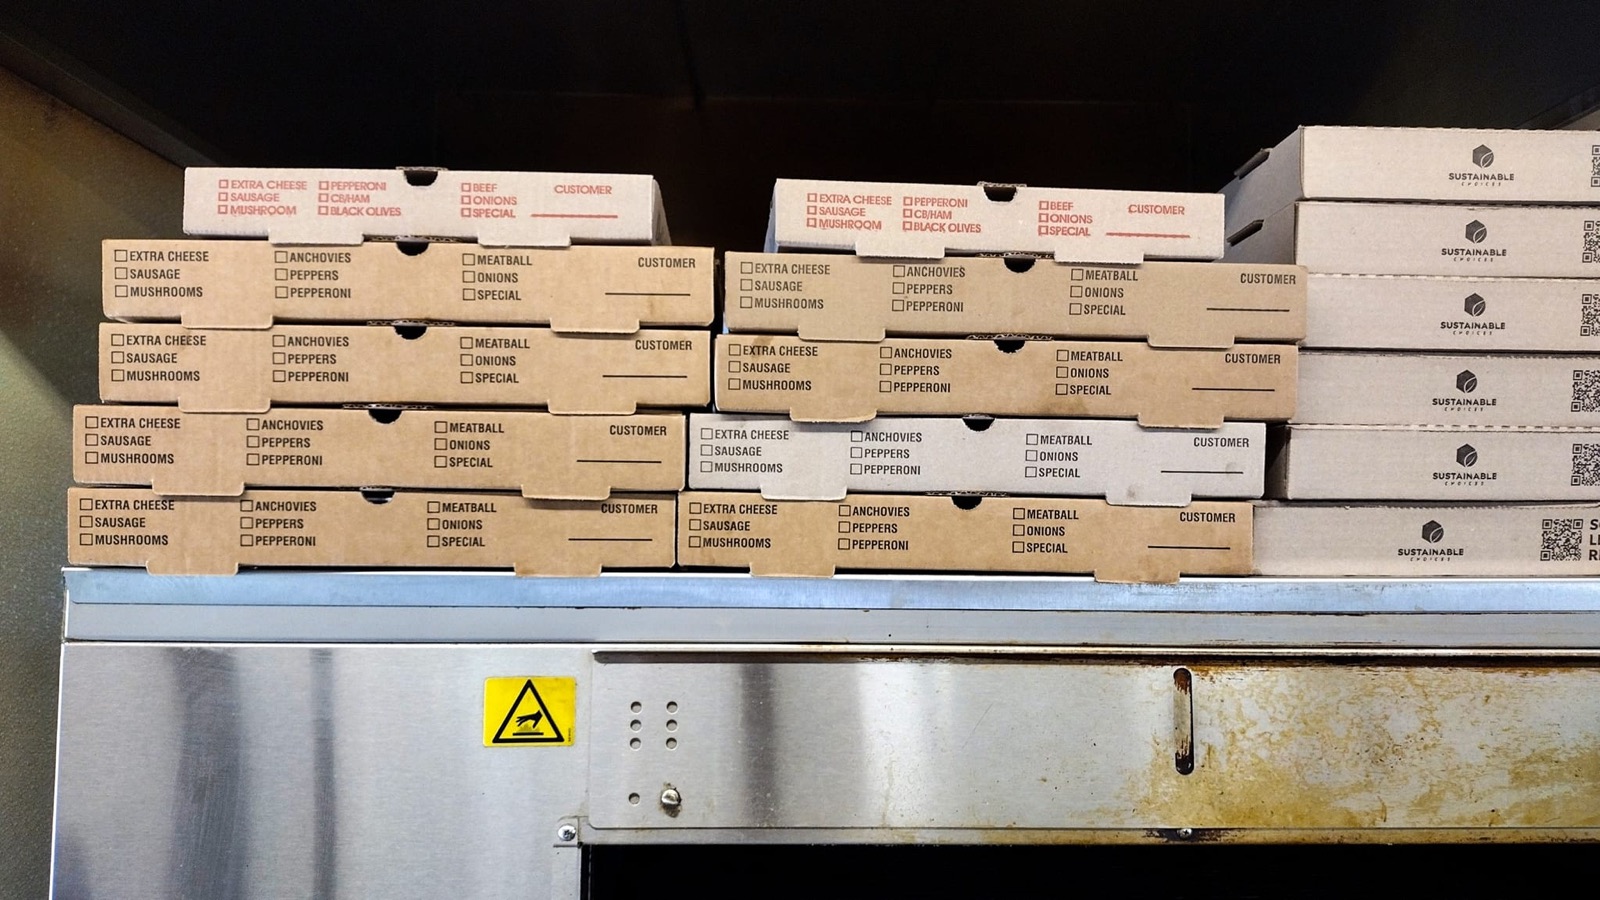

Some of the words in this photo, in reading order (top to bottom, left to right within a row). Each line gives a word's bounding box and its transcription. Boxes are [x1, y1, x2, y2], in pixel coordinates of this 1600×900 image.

[1449, 173, 1514, 181] SUSTAINABLE
[231, 180, 264, 189] EXTRA
[266, 180, 307, 190] CHEESE
[331, 181, 386, 191] PEPPERONI
[473, 183, 497, 193] BEEF
[554, 185, 612, 195] CUSTOMER
[230, 192, 280, 202] SAUSAGE
[330, 194, 370, 204] CB/HAM
[473, 195, 517, 206] ONIONS
[819, 194, 851, 204] EXTRA
[852, 195, 892, 206] CHEESE
[914, 197, 968, 208] PEPPERONI
[230, 205, 296, 216] MUSHROOM
[330, 206, 364, 216] BLACK
[365, 207, 402, 217] OLIVES
[819, 206, 866, 217] SAUSAGE
[1050, 201, 1074, 211] BEEF
[1128, 204, 1185, 215] CUSTOMER
[472, 208, 516, 218] SPECIAL
[914, 209, 952, 220] CB/HAM
[1050, 213, 1093, 224] ONIONS
[819, 219, 882, 231] MUSHROOM
[913, 222, 946, 233] BLACK
[948, 223, 981, 233] OLIVES
[1049, 226, 1091, 237] SPECIAL
[130, 251, 165, 261] EXTRA
[168, 251, 209, 262] CHEESE
[289, 252, 351, 263] ANCHOVIES
[1441, 248, 1506, 256] SUSTAINABLE
[477, 255, 533, 266] MEATBALL
[638, 257, 696, 268] CUSTOMER
[130, 269, 180, 279] SAUSAGE
[755, 263, 788, 274] EXTRA
[791, 264, 830, 275] CHEESE
[907, 266, 965, 278] ANCHOVIES
[290, 270, 339, 281] PEPPERS
[477, 272, 518, 283] ONIONS
[1085, 270, 1138, 281] MEATBALL
[1240, 273, 1296, 285] CUSTOMER
[130, 286, 203, 297] MUSHROOMS
[755, 280, 802, 292] SAUSAGE
[907, 284, 953, 295] PEPPERS
[290, 287, 351, 298] PEPPERONI
[477, 290, 522, 301] SPECIAL
[1085, 287, 1124, 298] ONIONS
[754, 298, 824, 309] MUSHROOMS
[906, 301, 963, 312] PEPPERONI
[1084, 304, 1126, 316] SPECIAL
[1440, 321, 1505, 330] SUSTAINABLE
[127, 335, 162, 345] EXTRA
[165, 335, 206, 346] CHEESE
[287, 336, 349, 347] ANCHOVIES
[475, 338, 530, 349] MEATBALL
[635, 339, 692, 350] CUSTOMER
[743, 345, 776, 356] EXTRA
[779, 346, 818, 356] CHEESE
[894, 348, 952, 359] ANCHOVIES
[126, 353, 177, 363] SAUSAGE
[288, 354, 337, 365] PEPPERS
[475, 356, 516, 366] ONIONS
[1071, 351, 1123, 362] MEATBALL
[1225, 353, 1281, 364] CUSTOMER
[743, 362, 790, 373] SAUSAGE
[894, 365, 940, 376] PEPPERS
[1071, 368, 1109, 378] ONIONS
[127, 370, 200, 381] MUSHROOMS
[288, 371, 349, 382] PEPPERONI
[475, 373, 519, 383] SPECIAL
[743, 380, 812, 391] MUSHROOMS
[894, 382, 950, 393] PEPPERONI
[1070, 385, 1111, 395] SPECIAL
[1432, 398, 1497, 406] SUSTAINABLE
[101, 417, 137, 428] EXTRA
[139, 418, 180, 429] CHEESE
[261, 420, 324, 431] ANCHOVIES
[450, 422, 504, 433] MEATBALL
[610, 425, 667, 436] CUSTOMER
[715, 429, 747, 439] EXTRA
[751, 430, 789, 440] CHEESE
[101, 435, 151, 446] SAUSAGE
[262, 437, 311, 448] PEPPERS
[864, 432, 922, 443] ANCHOVIES
[1040, 435, 1092, 445] MEATBALL
[1194, 437, 1249, 448] CUSTOMER
[449, 440, 490, 450] ONIONS
[715, 446, 762, 456] SAUSAGE
[864, 448, 910, 459] PEPPERS
[1040, 451, 1078, 461] ONIONS
[101, 453, 174, 464] MUSHROOMS
[262, 455, 322, 466] PEPPERONI
[449, 457, 493, 468] SPECIAL
[715, 462, 783, 473] MUSHROOMS
[864, 465, 920, 475] PEPPERONI
[1039, 467, 1080, 478] SPECIAL
[1433, 472, 1497, 480] SUSTAINABLE
[95, 499, 130, 510] EXTRA
[133, 500, 175, 510] CHEESE
[255, 501, 317, 512] ANCHOVIES
[442, 502, 497, 513] MEATBALL
[601, 503, 658, 514] CUSTOMER
[703, 504, 736, 514] EXTRA
[739, 504, 777, 515] CHEESE
[852, 506, 910, 517] ANCHOVIES
[1027, 509, 1079, 520] MEATBALL
[1180, 511, 1235, 523] CUSTOMER
[95, 517, 146, 528] SAUSAGE
[255, 518, 304, 529] PEPPERS
[442, 519, 483, 530] ONIONS
[703, 520, 750, 531] SAUSAGE
[852, 523, 898, 534] PEPPERS
[1027, 526, 1065, 536] ONIONS
[95, 534, 168, 546] MUSHROOMS
[255, 536, 316, 546] PEPPERONI
[442, 536, 485, 547] SPECIAL
[703, 537, 771, 548] MUSHROOMS
[852, 539, 908, 550] PEPPERONI
[1026, 542, 1068, 553] SPECIAL
[1398, 548, 1464, 556] SUSTAINABLE
